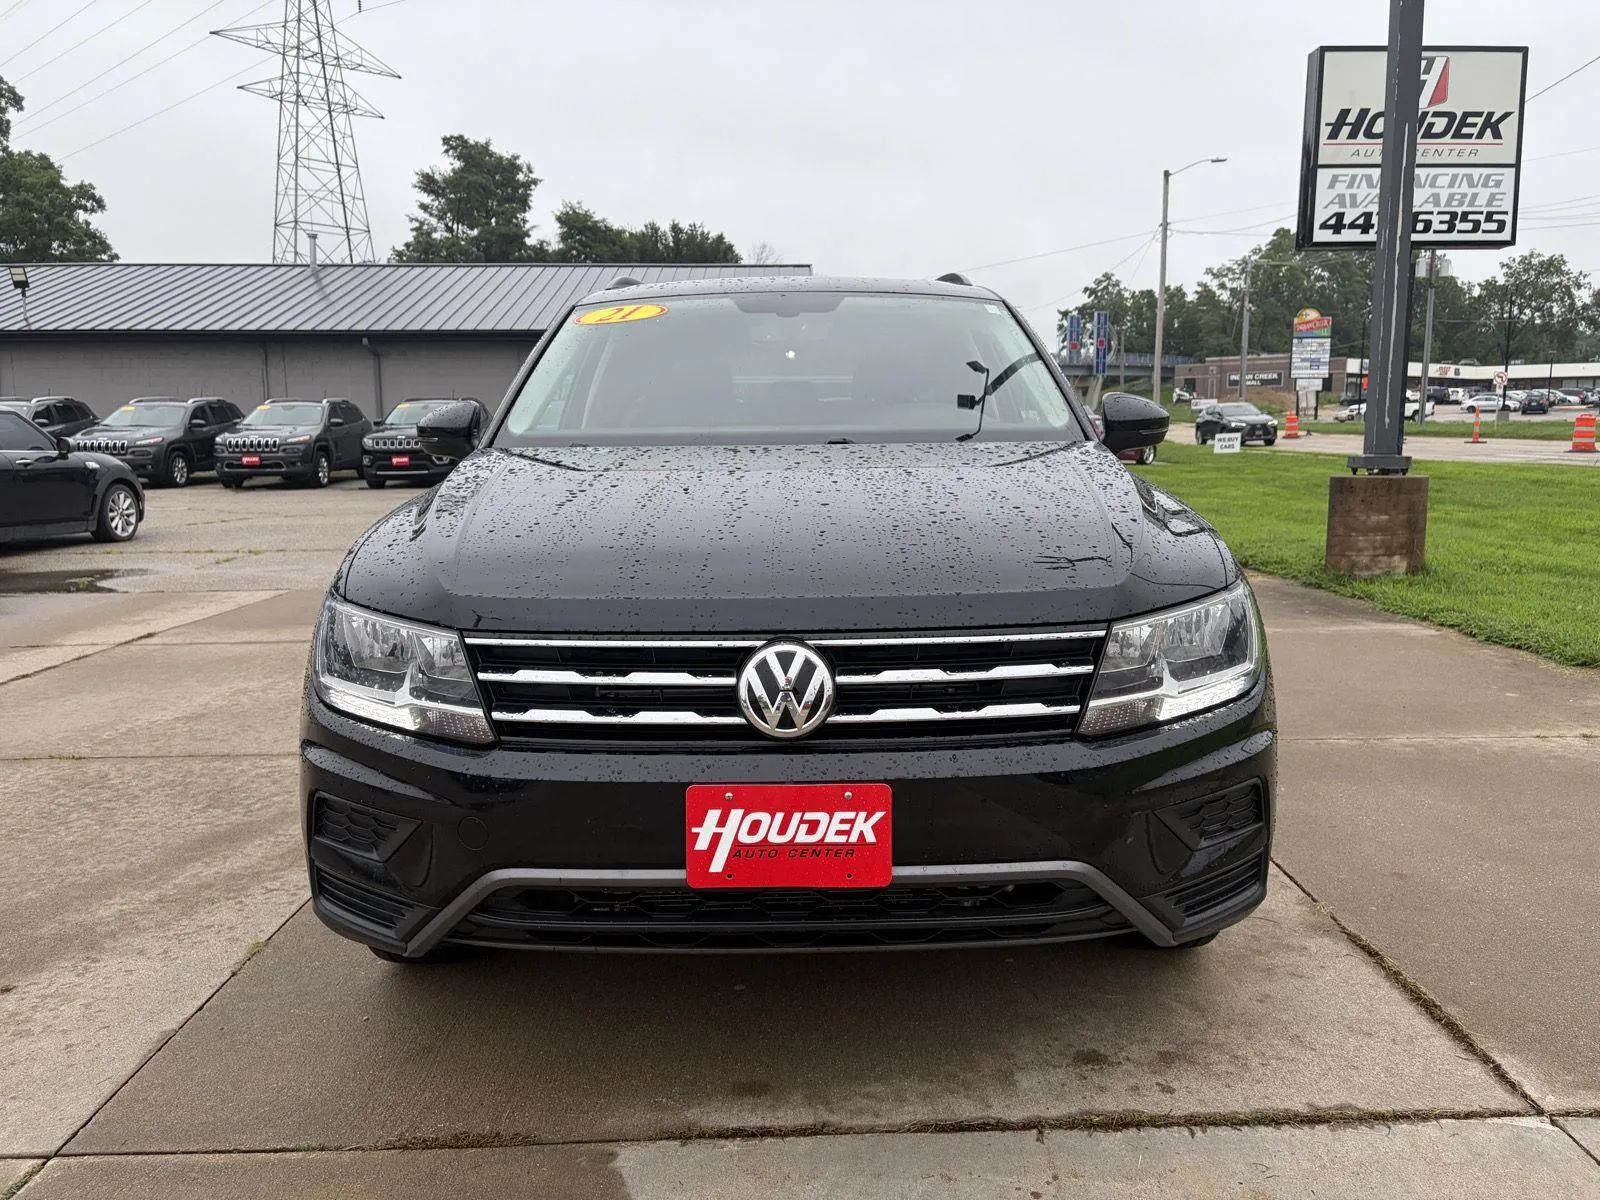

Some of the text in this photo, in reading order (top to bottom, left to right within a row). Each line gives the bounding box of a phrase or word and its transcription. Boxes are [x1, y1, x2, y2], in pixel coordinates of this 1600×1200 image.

[1417, 148, 1479, 158] ENTER
[1327, 173, 1505, 190] FINNCING
[691, 808, 886, 872] HOUDEK
[732, 848, 856, 858] AUTO CENTER
